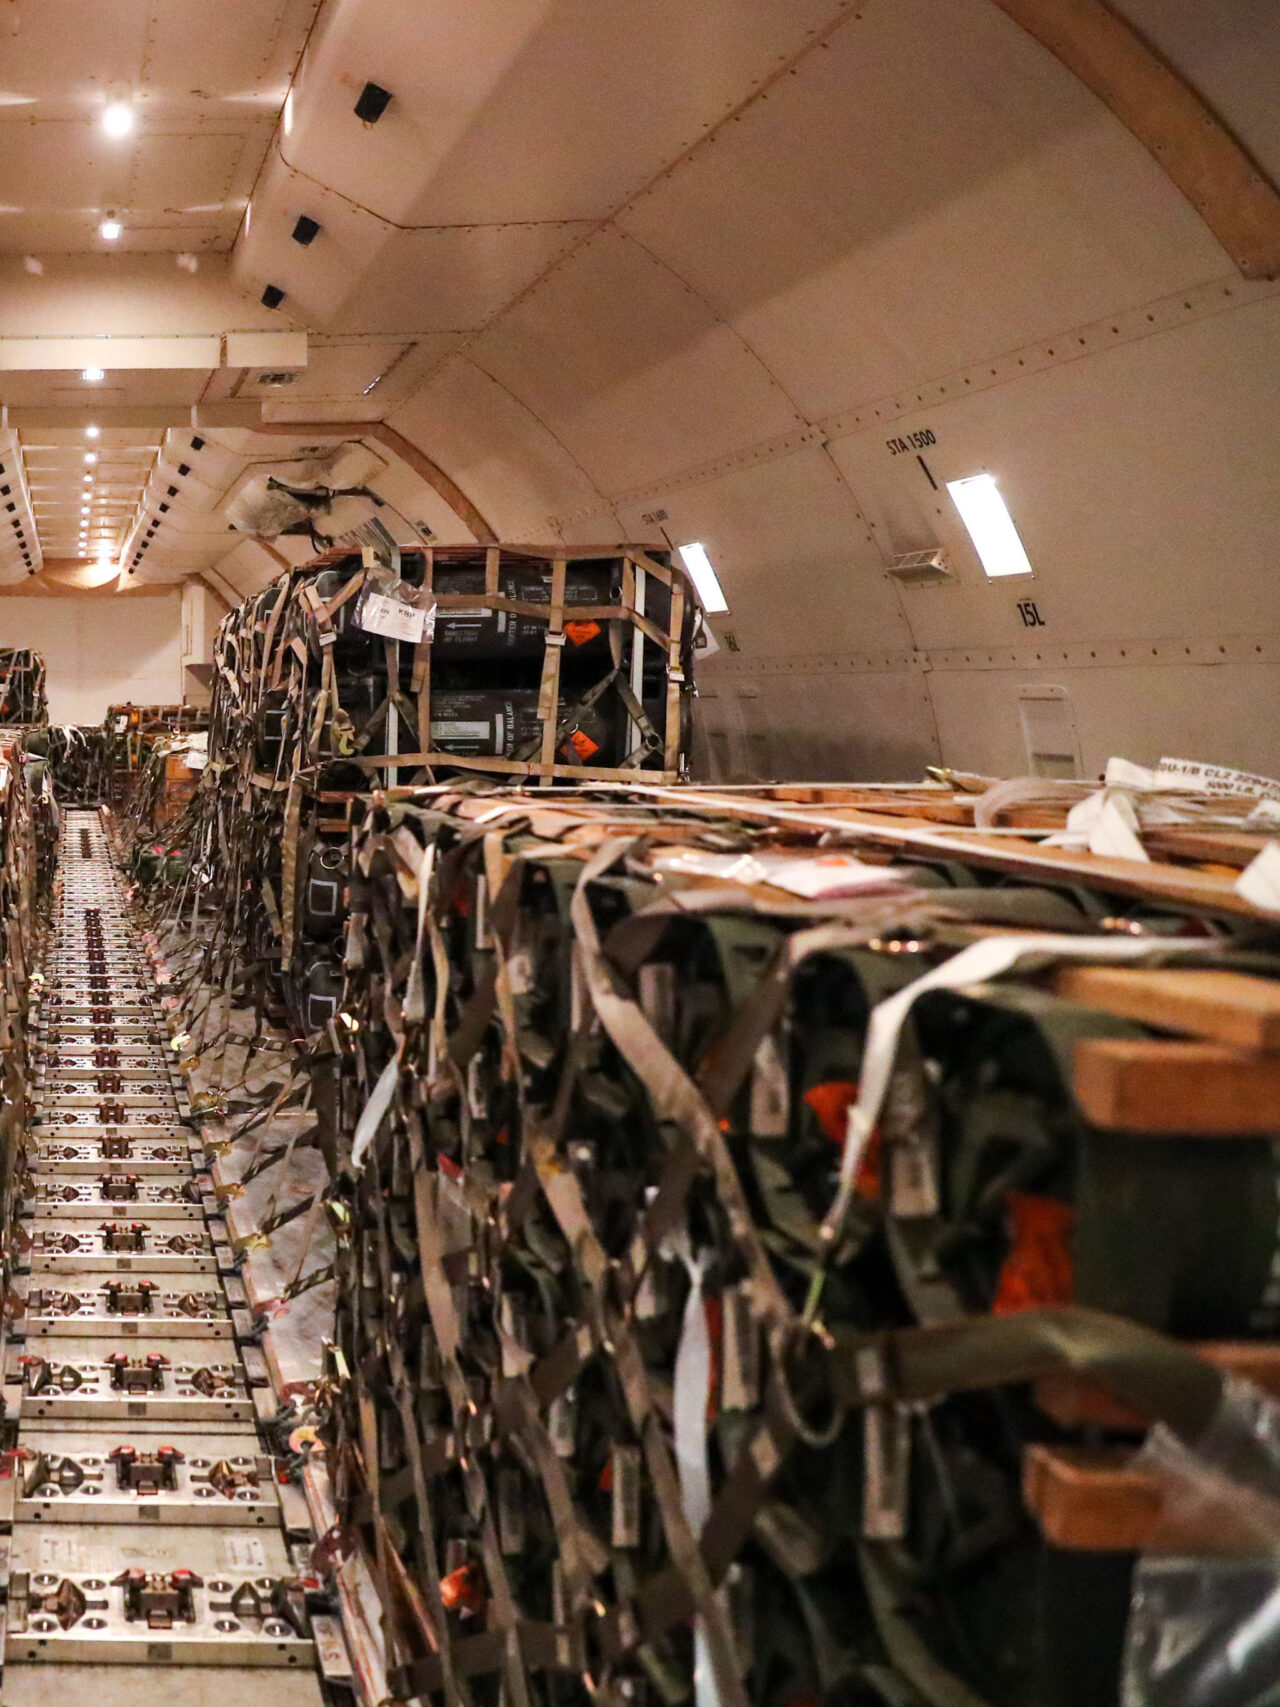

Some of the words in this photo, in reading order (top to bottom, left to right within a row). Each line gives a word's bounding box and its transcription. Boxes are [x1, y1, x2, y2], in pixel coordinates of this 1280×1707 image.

[886, 436, 910, 456] STA
[906, 429, 937, 449] 1500
[1017, 602, 1046, 627] 15L
